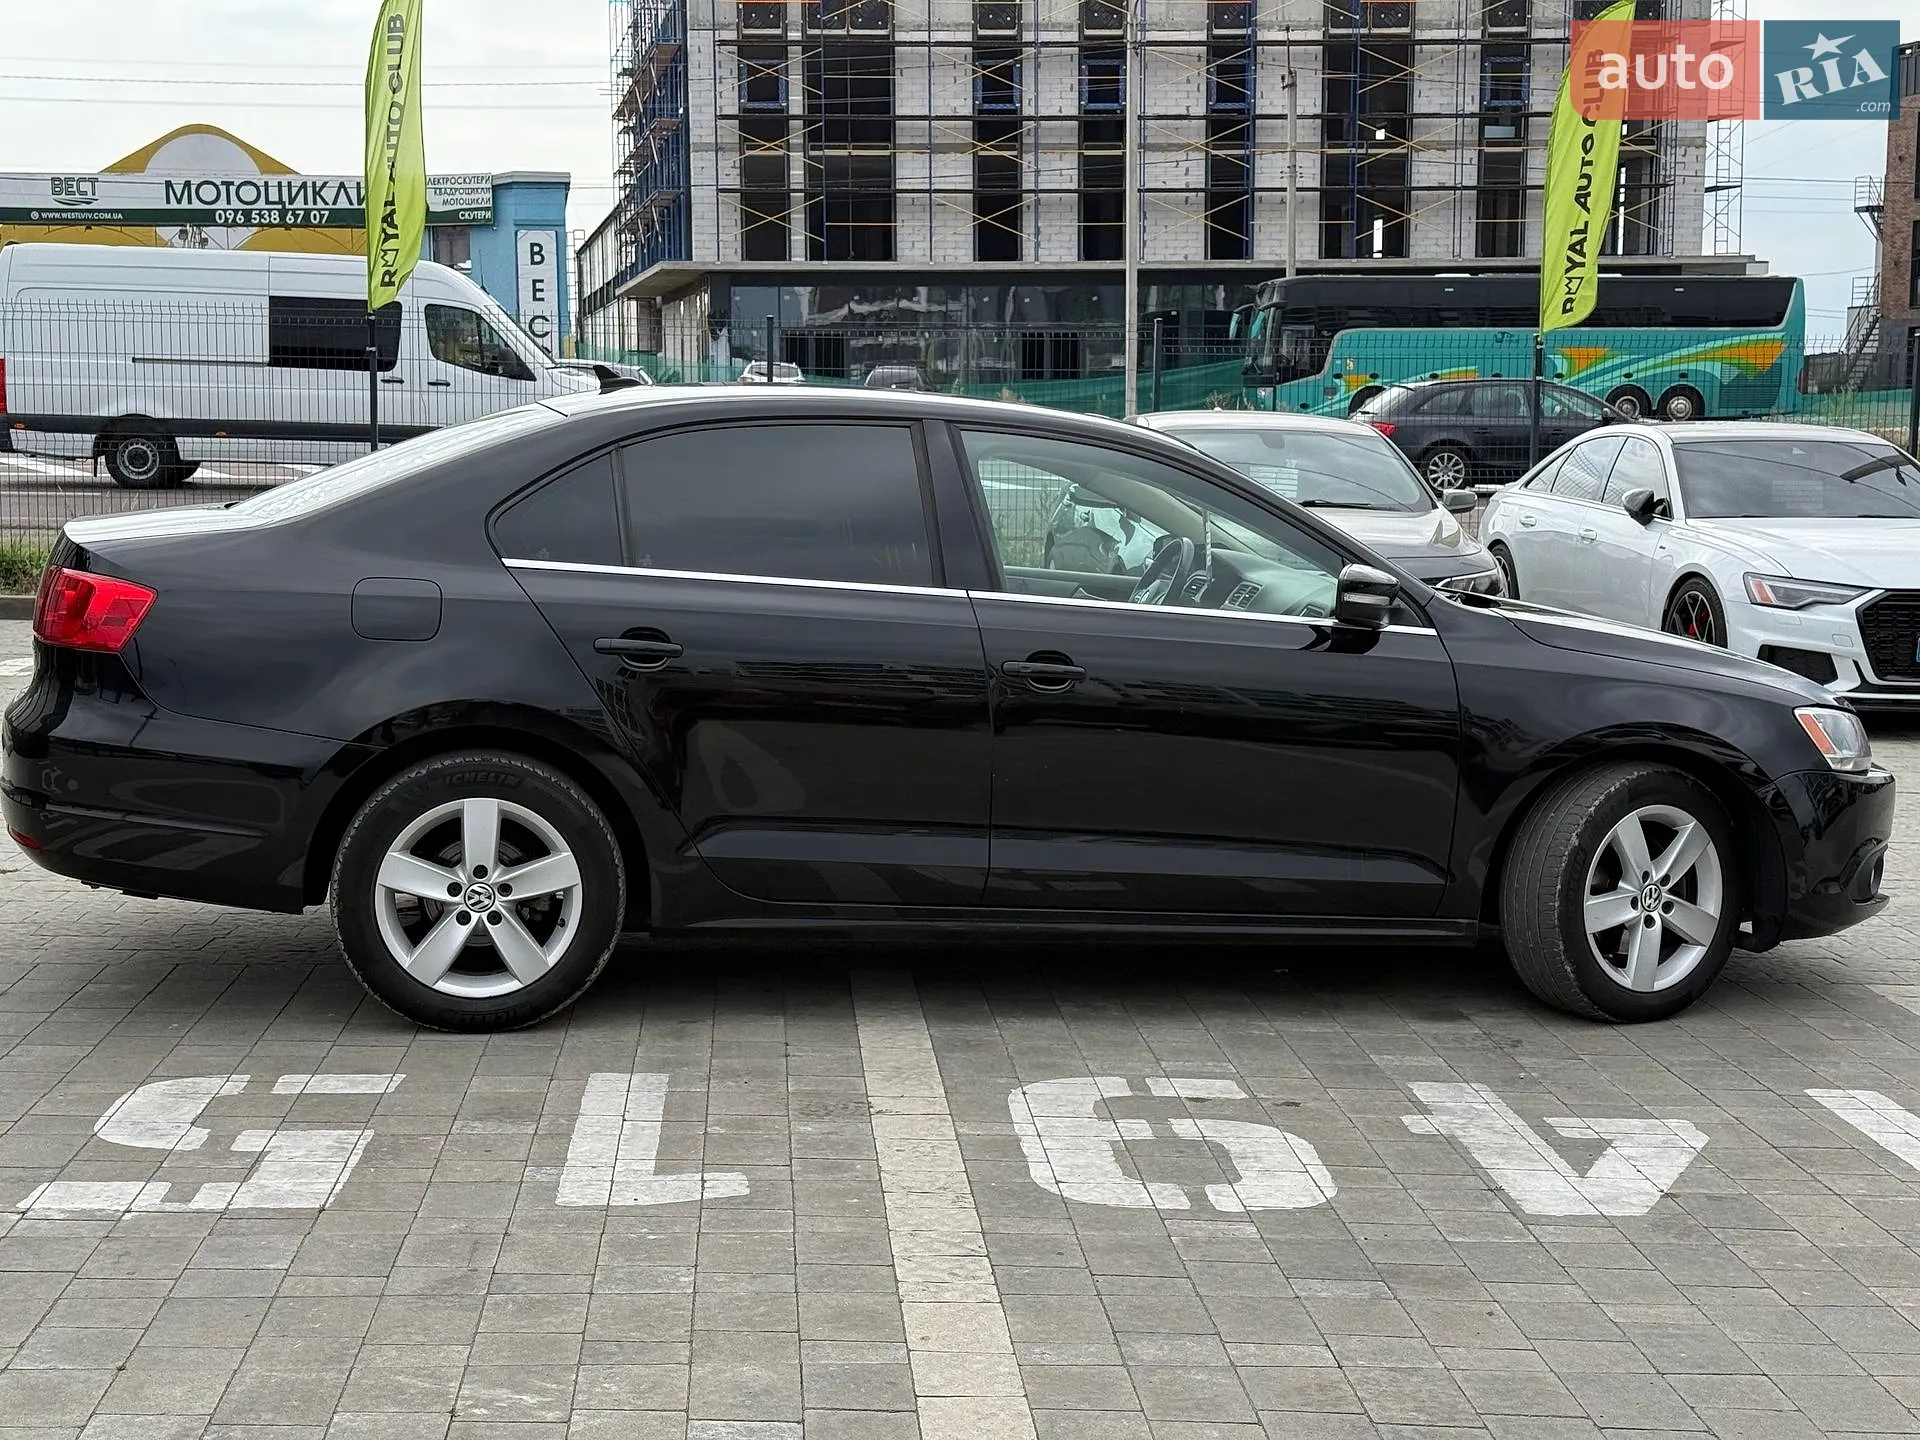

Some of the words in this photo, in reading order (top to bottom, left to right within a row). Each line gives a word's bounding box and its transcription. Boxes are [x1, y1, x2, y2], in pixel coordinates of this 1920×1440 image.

[387, 13, 405, 95] CLUB
[1574, 132, 1595, 215] AUTO
[215, 210, 245, 225] 096
[250, 210, 280, 225] 538
[285, 210, 304, 225] 67
[310, 211, 329, 225] 07
[458, 210, 492, 220] СКУТЕРИ
[528, 242, 552, 353] ВЕС
